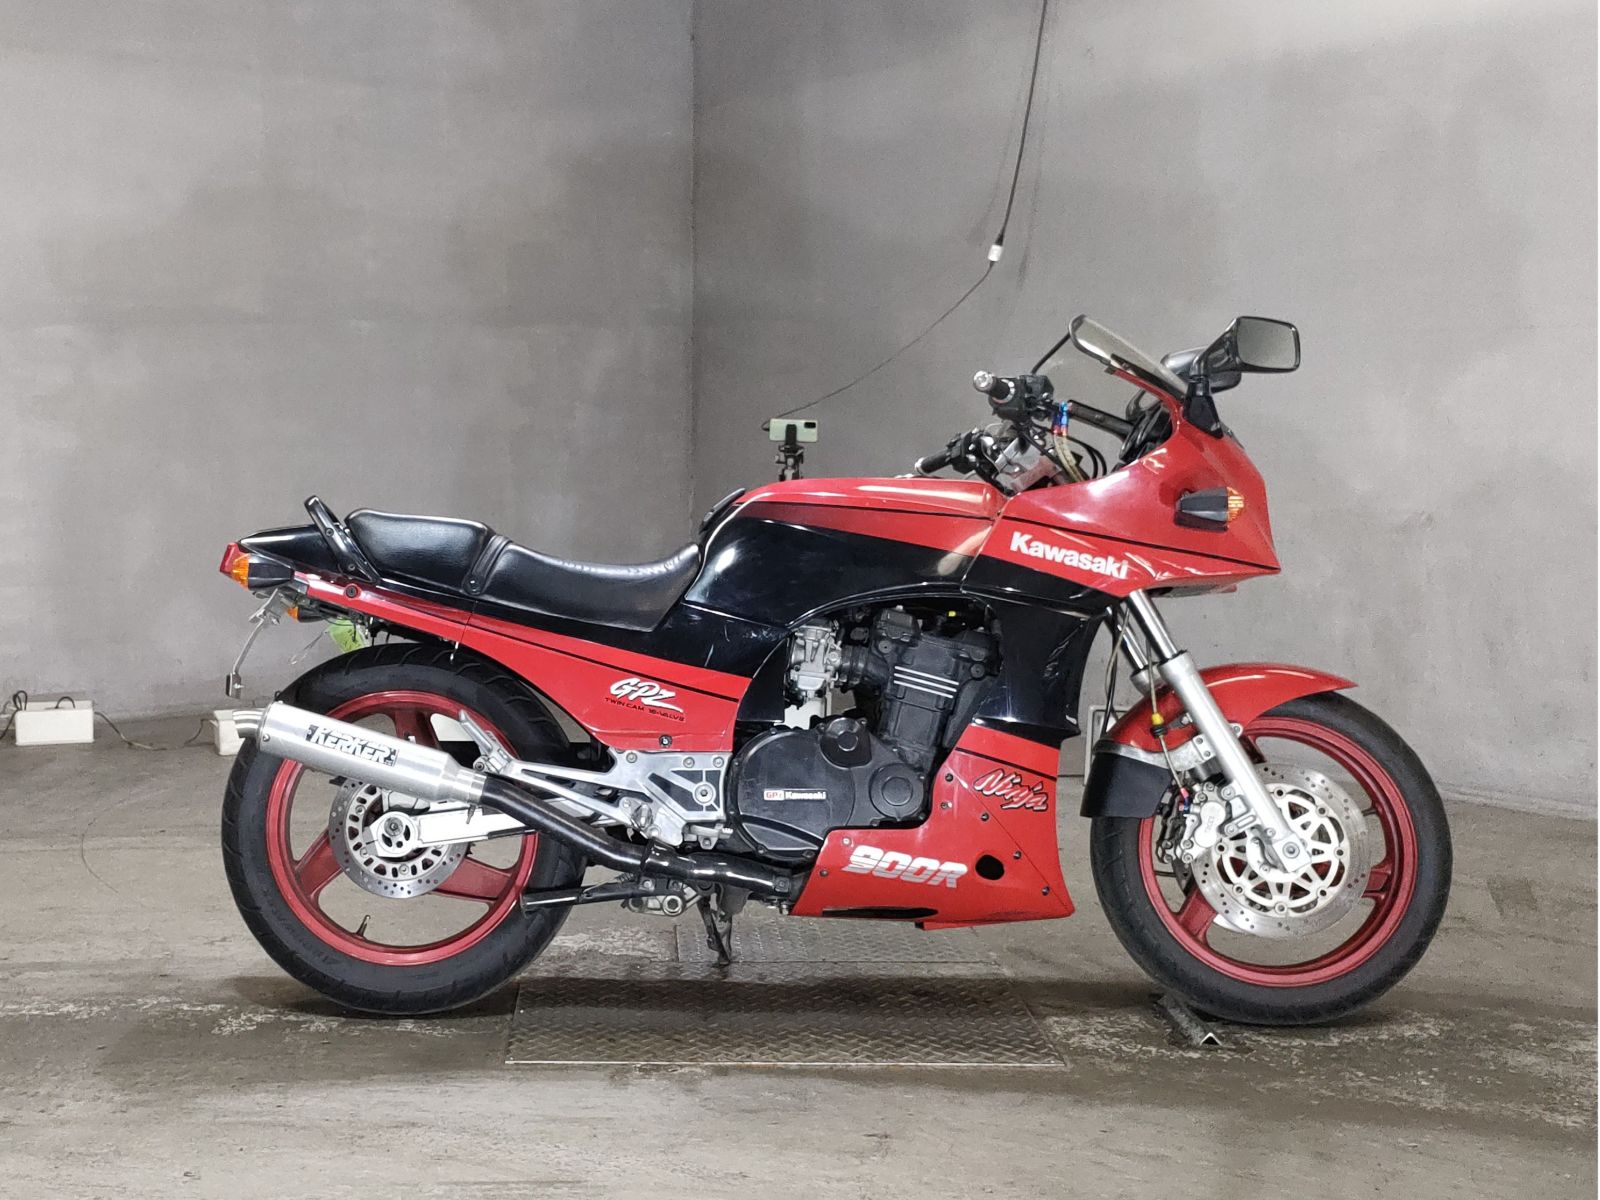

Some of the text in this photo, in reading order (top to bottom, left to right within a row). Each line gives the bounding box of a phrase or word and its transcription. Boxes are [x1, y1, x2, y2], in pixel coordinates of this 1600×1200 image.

[1010, 531, 1129, 580] Kawasaki
[605, 697, 625, 706] TWIN
[626, 703, 645, 712] CAM
[308, 726, 392, 765] KERKER
[785, 791, 827, 800] Kawasaki
[973, 768, 1049, 812] Ninja
[841, 845, 968, 889] 900R
